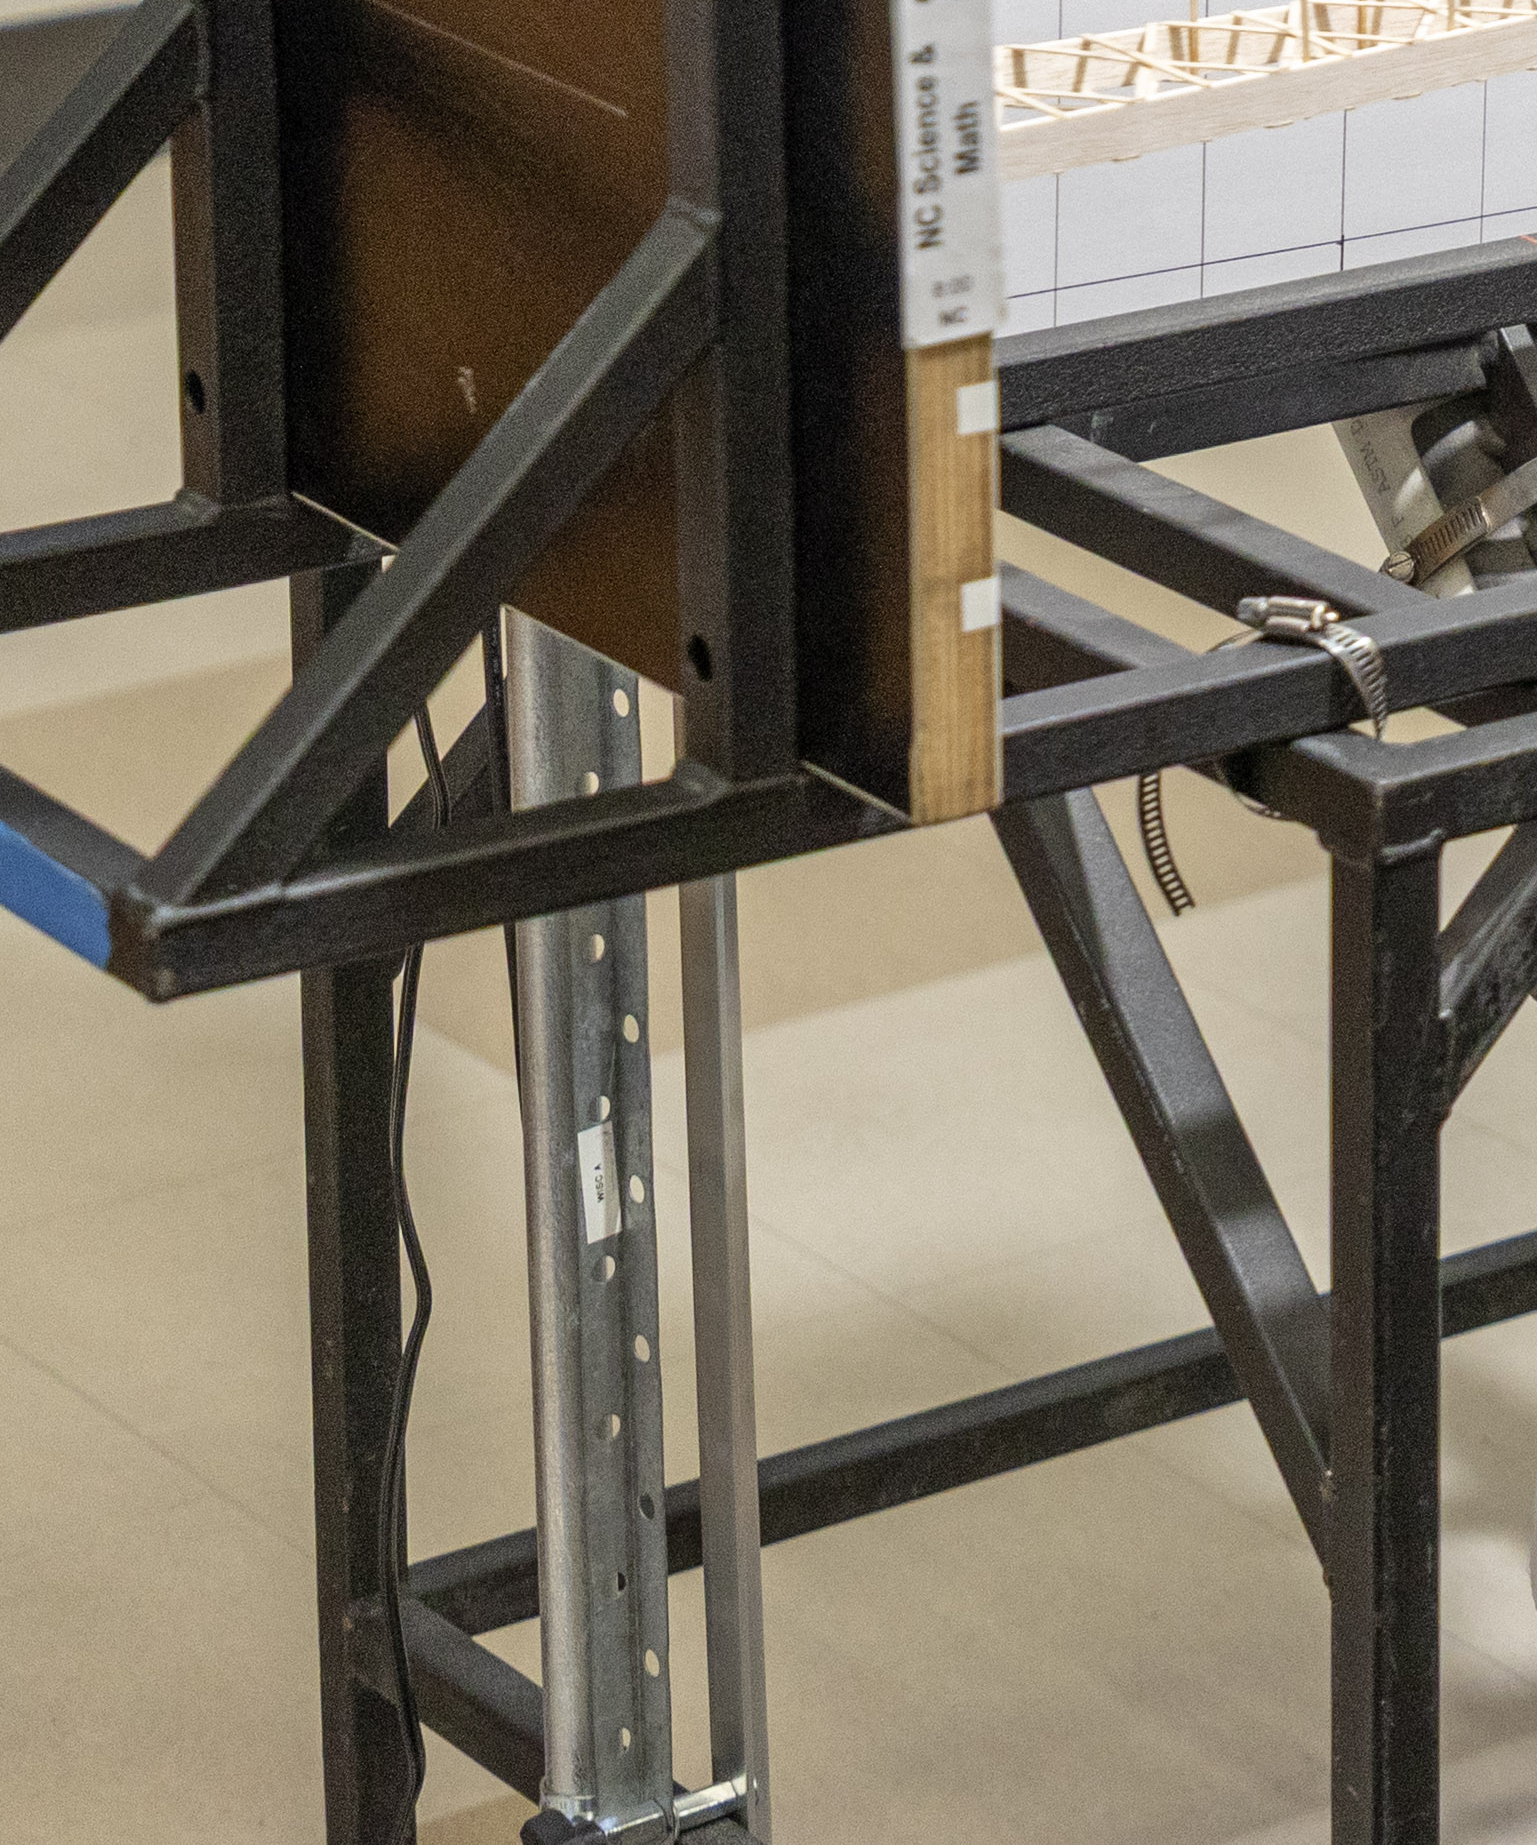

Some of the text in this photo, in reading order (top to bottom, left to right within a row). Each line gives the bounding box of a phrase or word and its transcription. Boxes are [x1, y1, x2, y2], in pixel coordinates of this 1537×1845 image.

[910, 75, 941, 196] Science
[953, 100, 982, 176] Math
[913, 202, 943, 249] NC
